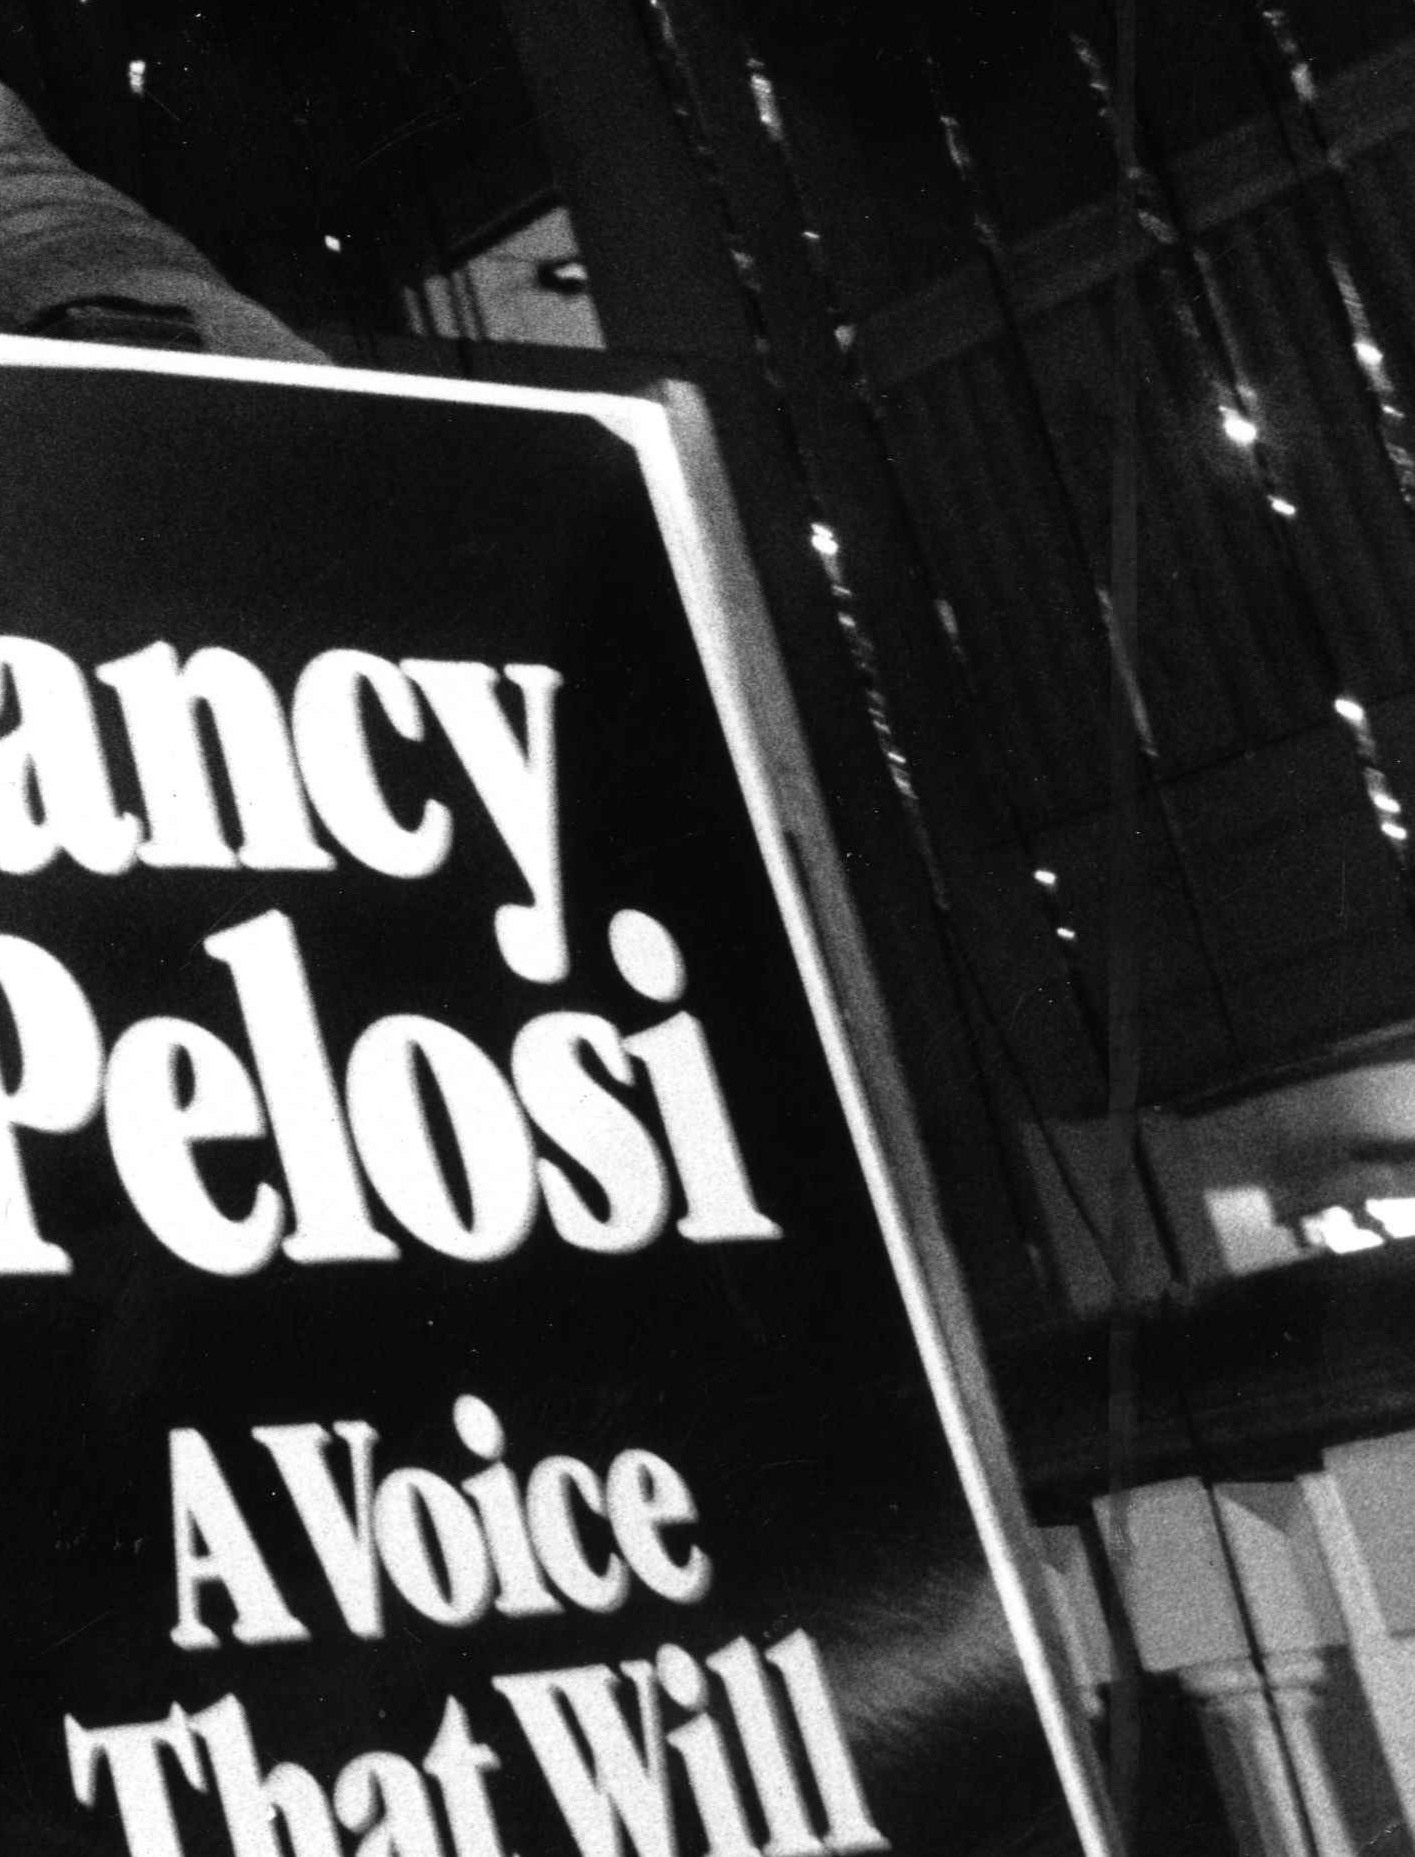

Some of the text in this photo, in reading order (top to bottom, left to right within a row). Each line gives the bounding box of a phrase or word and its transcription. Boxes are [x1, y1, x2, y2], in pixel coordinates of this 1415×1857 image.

[168, 1393, 710, 1650] A Voice
[63, 1627, 891, 1857] That Will
